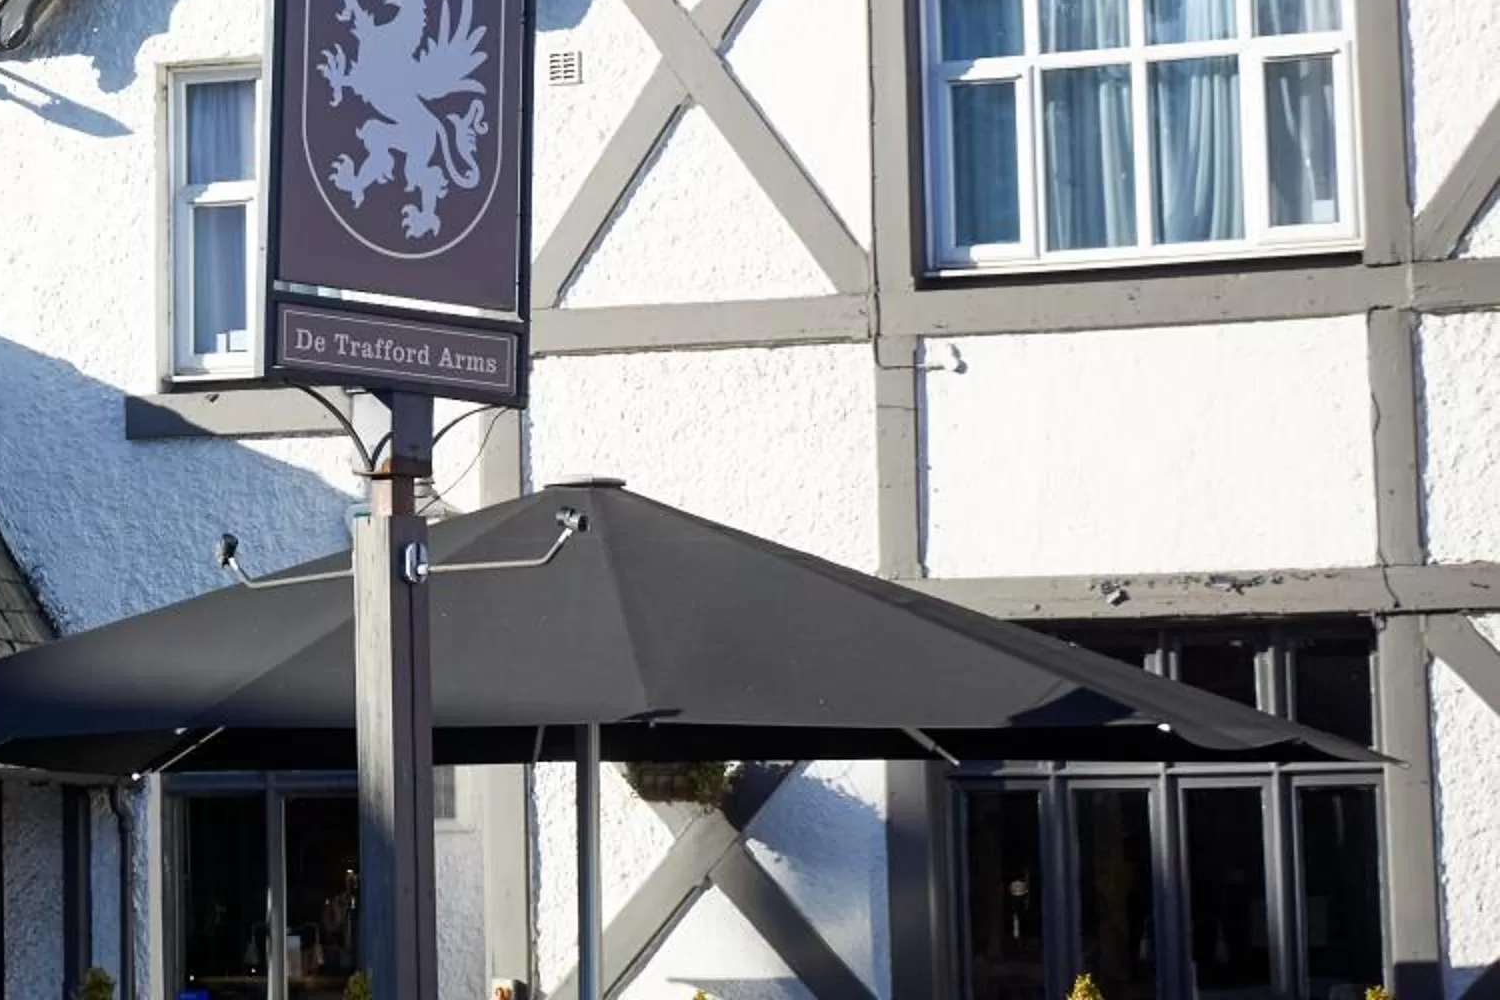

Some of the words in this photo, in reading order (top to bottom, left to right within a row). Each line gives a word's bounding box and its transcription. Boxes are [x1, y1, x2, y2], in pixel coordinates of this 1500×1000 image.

[294, 328, 326, 351] De
[333, 333, 429, 366] Trafford
[438, 348, 498, 373] Arms
